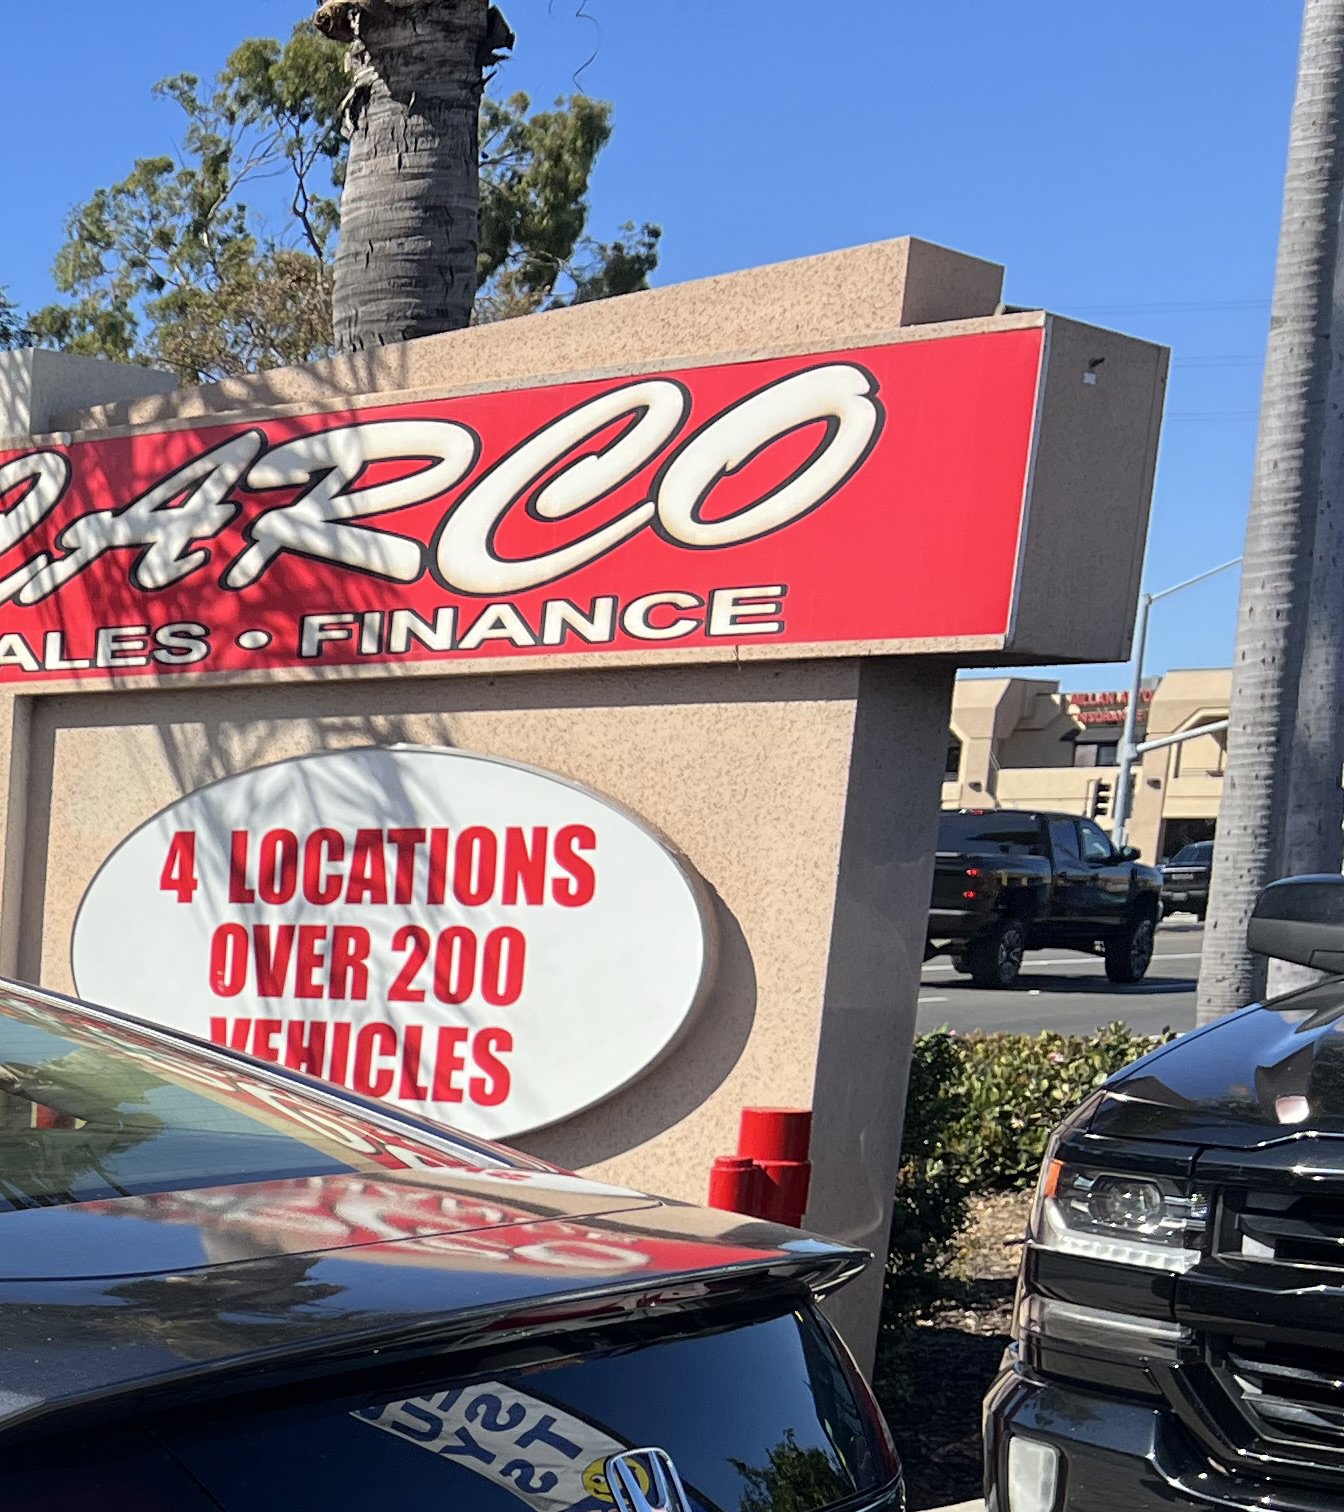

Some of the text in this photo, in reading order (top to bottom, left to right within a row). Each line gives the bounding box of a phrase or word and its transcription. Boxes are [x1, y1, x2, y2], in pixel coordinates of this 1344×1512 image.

[299, 584, 786, 657] FINANCE
[160, 825, 597, 908] 4 LOCATIONS
[209, 922, 527, 1007] OVER 200
